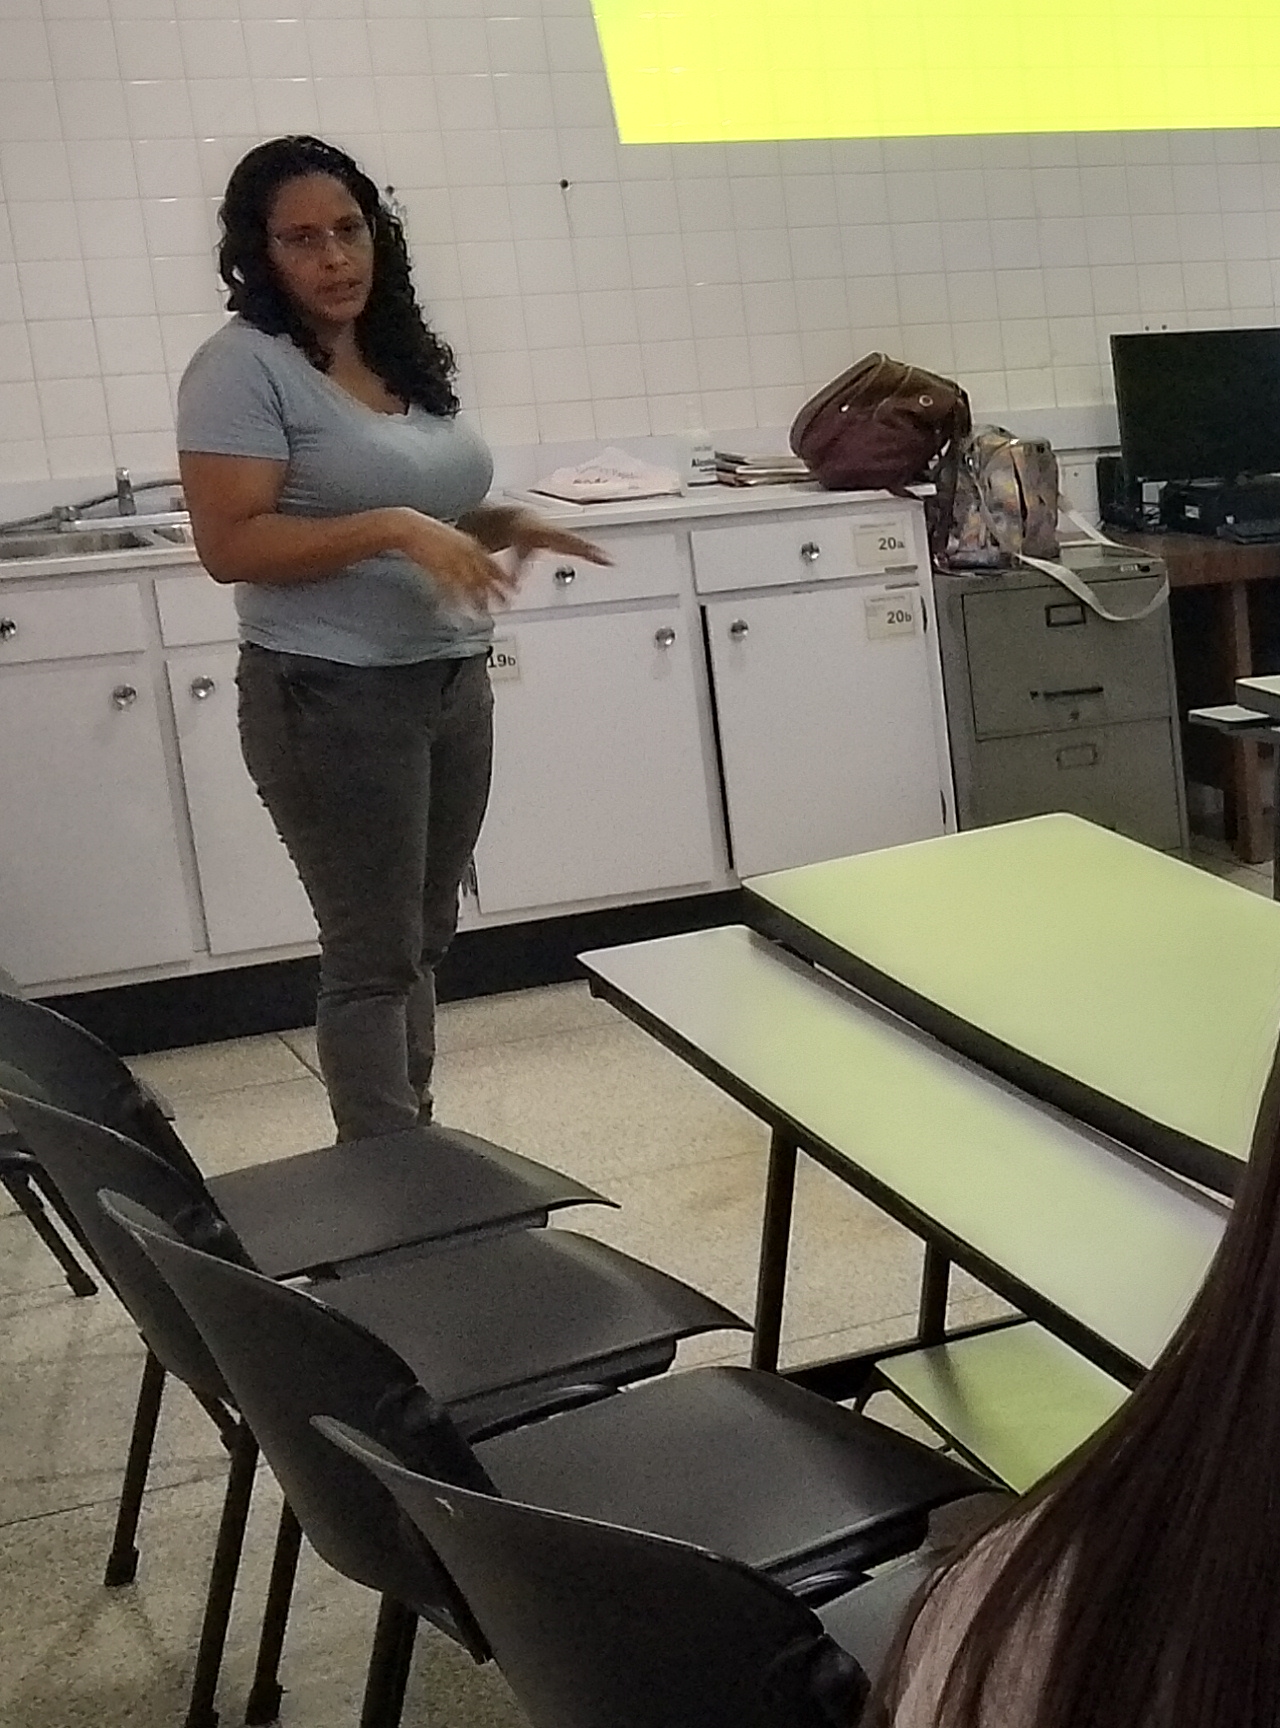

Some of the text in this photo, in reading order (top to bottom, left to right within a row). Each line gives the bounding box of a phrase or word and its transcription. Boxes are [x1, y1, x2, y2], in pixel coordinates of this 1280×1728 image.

[878, 536, 905, 551] 20a
[886, 609, 912, 624] 20b
[487, 653, 516, 669] 19b
